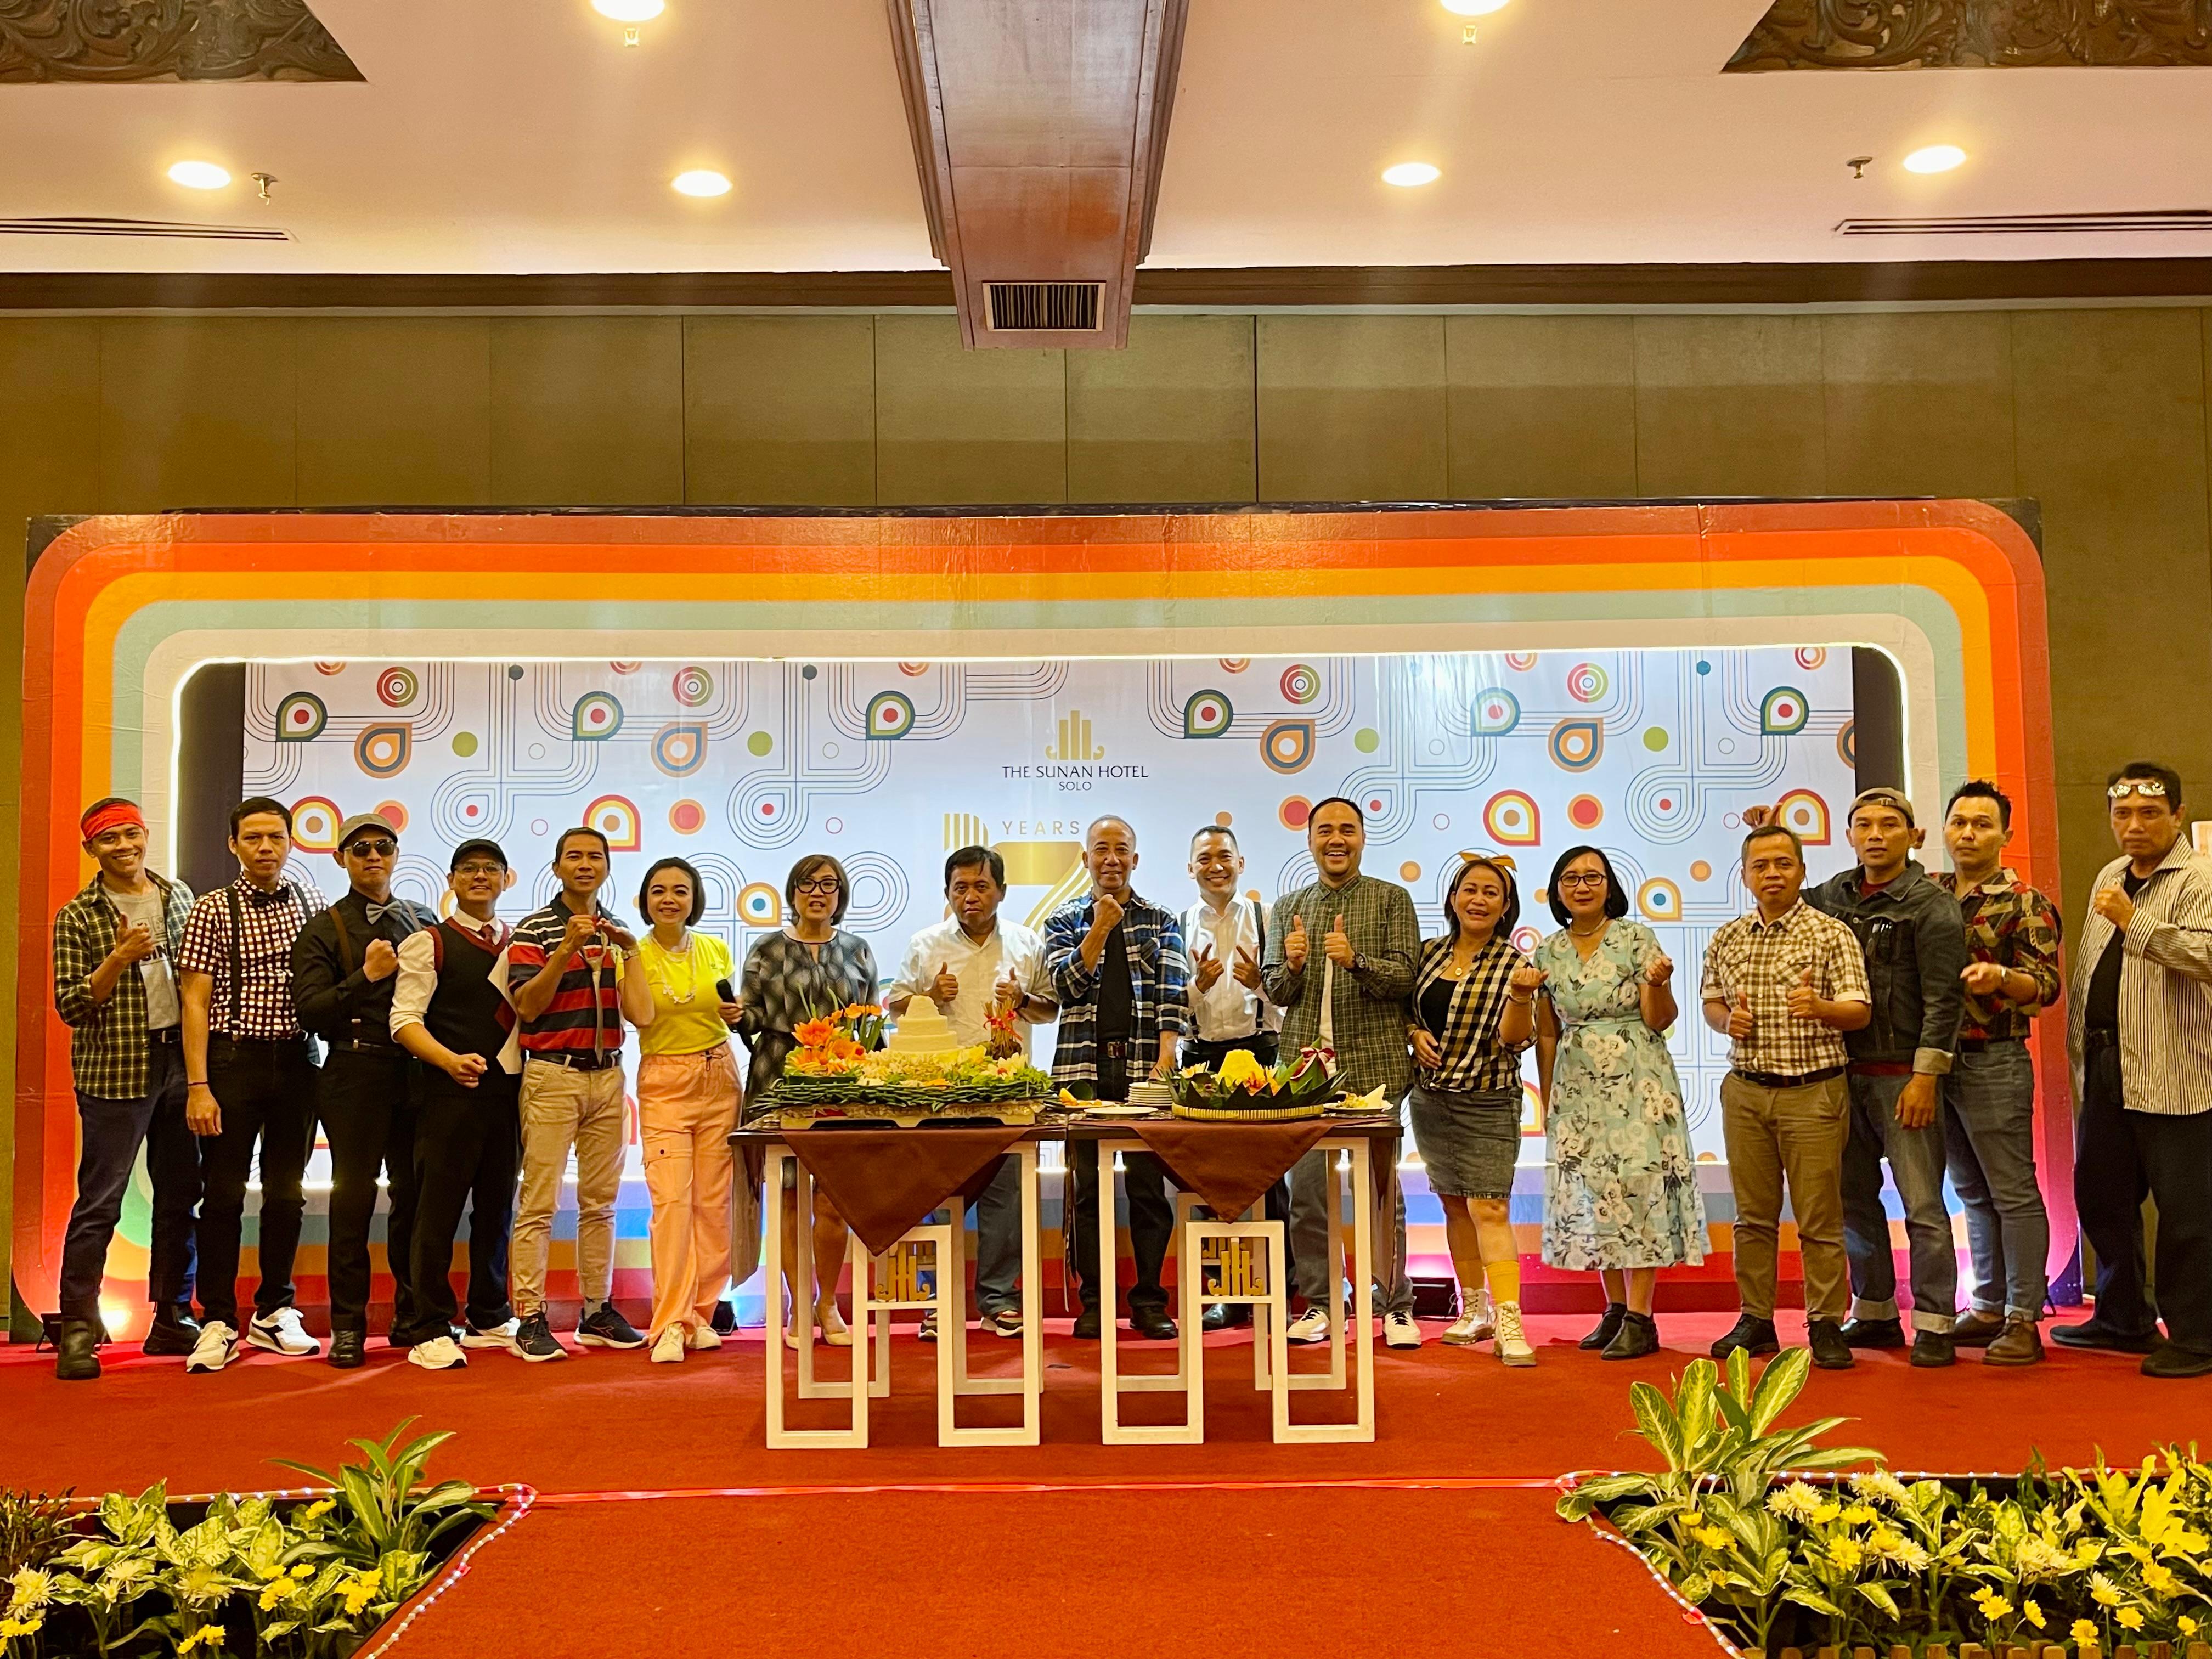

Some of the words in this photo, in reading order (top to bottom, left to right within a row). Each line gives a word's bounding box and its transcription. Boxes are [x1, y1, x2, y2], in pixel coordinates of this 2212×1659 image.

[1001, 766, 1031, 778] THE
[1035, 765, 1093, 778] SUNAN
[1098, 765, 1149, 778] HOTEL
[1058, 781, 1092, 791] SOLO
[1002, 821, 1080, 835] YEARS
